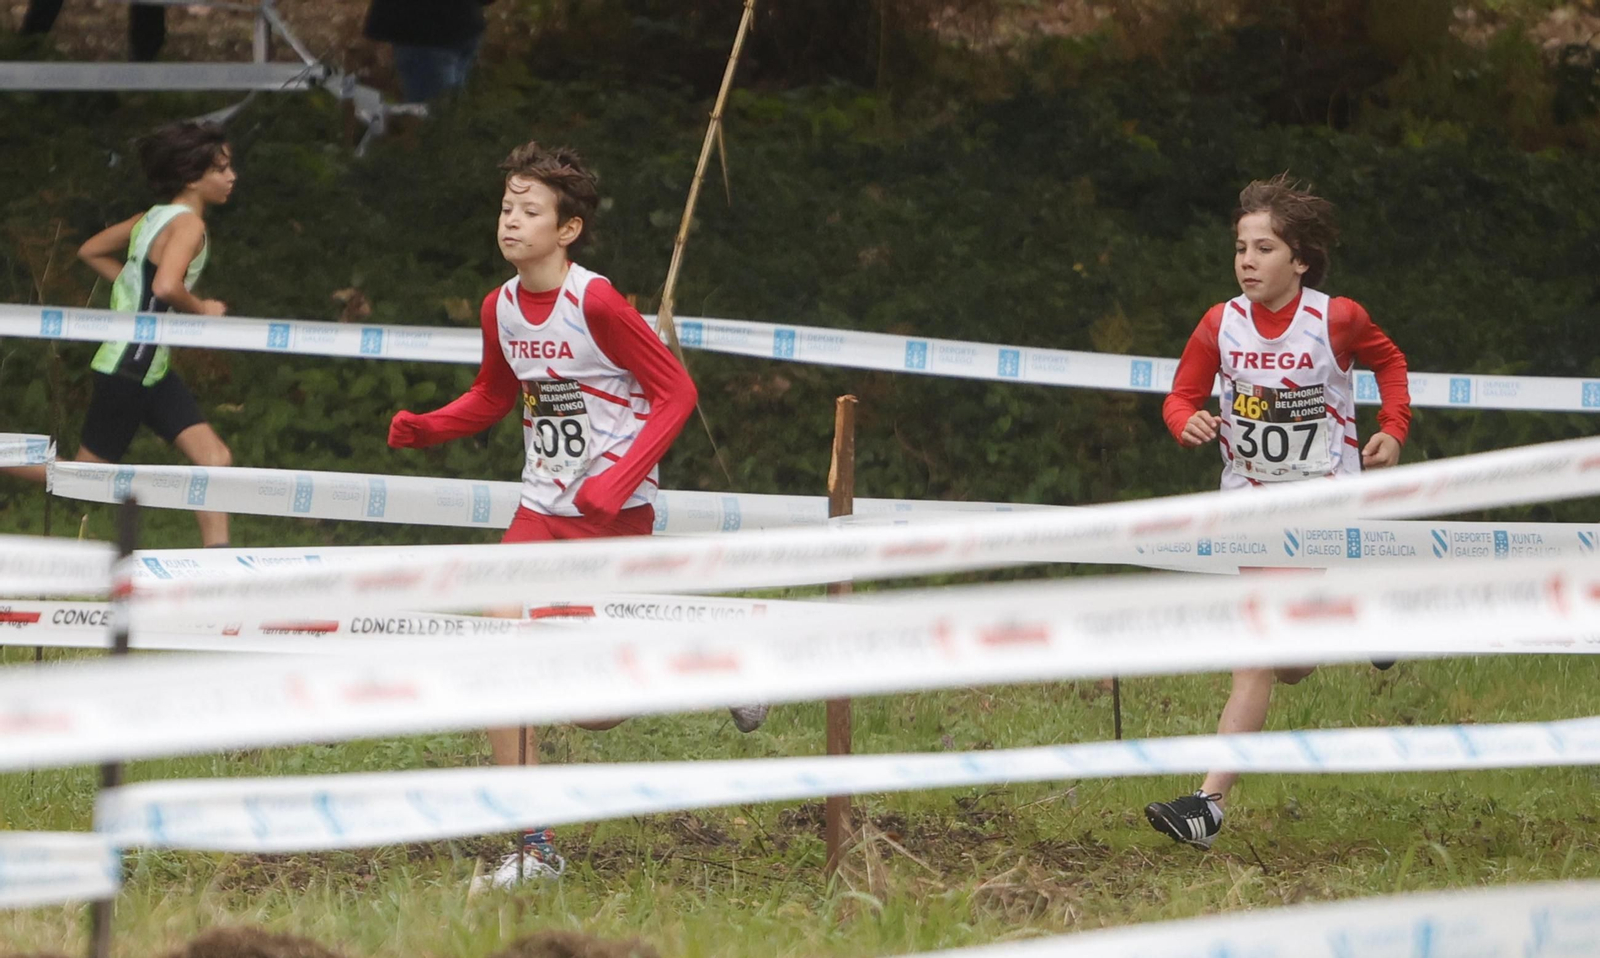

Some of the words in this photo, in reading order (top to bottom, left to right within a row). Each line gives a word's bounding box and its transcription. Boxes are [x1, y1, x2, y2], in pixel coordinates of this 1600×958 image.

[508, 340, 575, 360] TREGA
[1229, 350, 1315, 370] TREGA
[540, 381, 580, 393] MEMORIAL
[1279, 386, 1324, 400] MEMORIAL
[539, 391, 582, 403] BELARMINO
[1274, 395, 1325, 409] BELARMINO
[552, 401, 584, 412] ALONSO
[1289, 405, 1326, 418] ALONSO
[1236, 419, 1319, 463] 307
[1305, 529, 1345, 542] DEPORTE
[1362, 531, 1396, 543] XUNTA
[1453, 532, 1492, 544] DEPORTE
[1510, 533, 1544, 545] XUNTA
[1156, 542, 1192, 554] GALEGO
[1213, 542, 1228, 554] DE
[1229, 542, 1269, 555] GALICIA
[1306, 544, 1342, 557] GALEGO
[1363, 544, 1377, 557] DE
[1378, 545, 1417, 557] GALICIA
[1454, 546, 1490, 558] GALEGO
[161, 558, 200, 569] XUNTA
[604, 603, 683, 622] CONCELLO
[686, 605, 706, 623] DE
[350, 616, 440, 635] CONCELLO
[444, 619, 465, 636] DE
